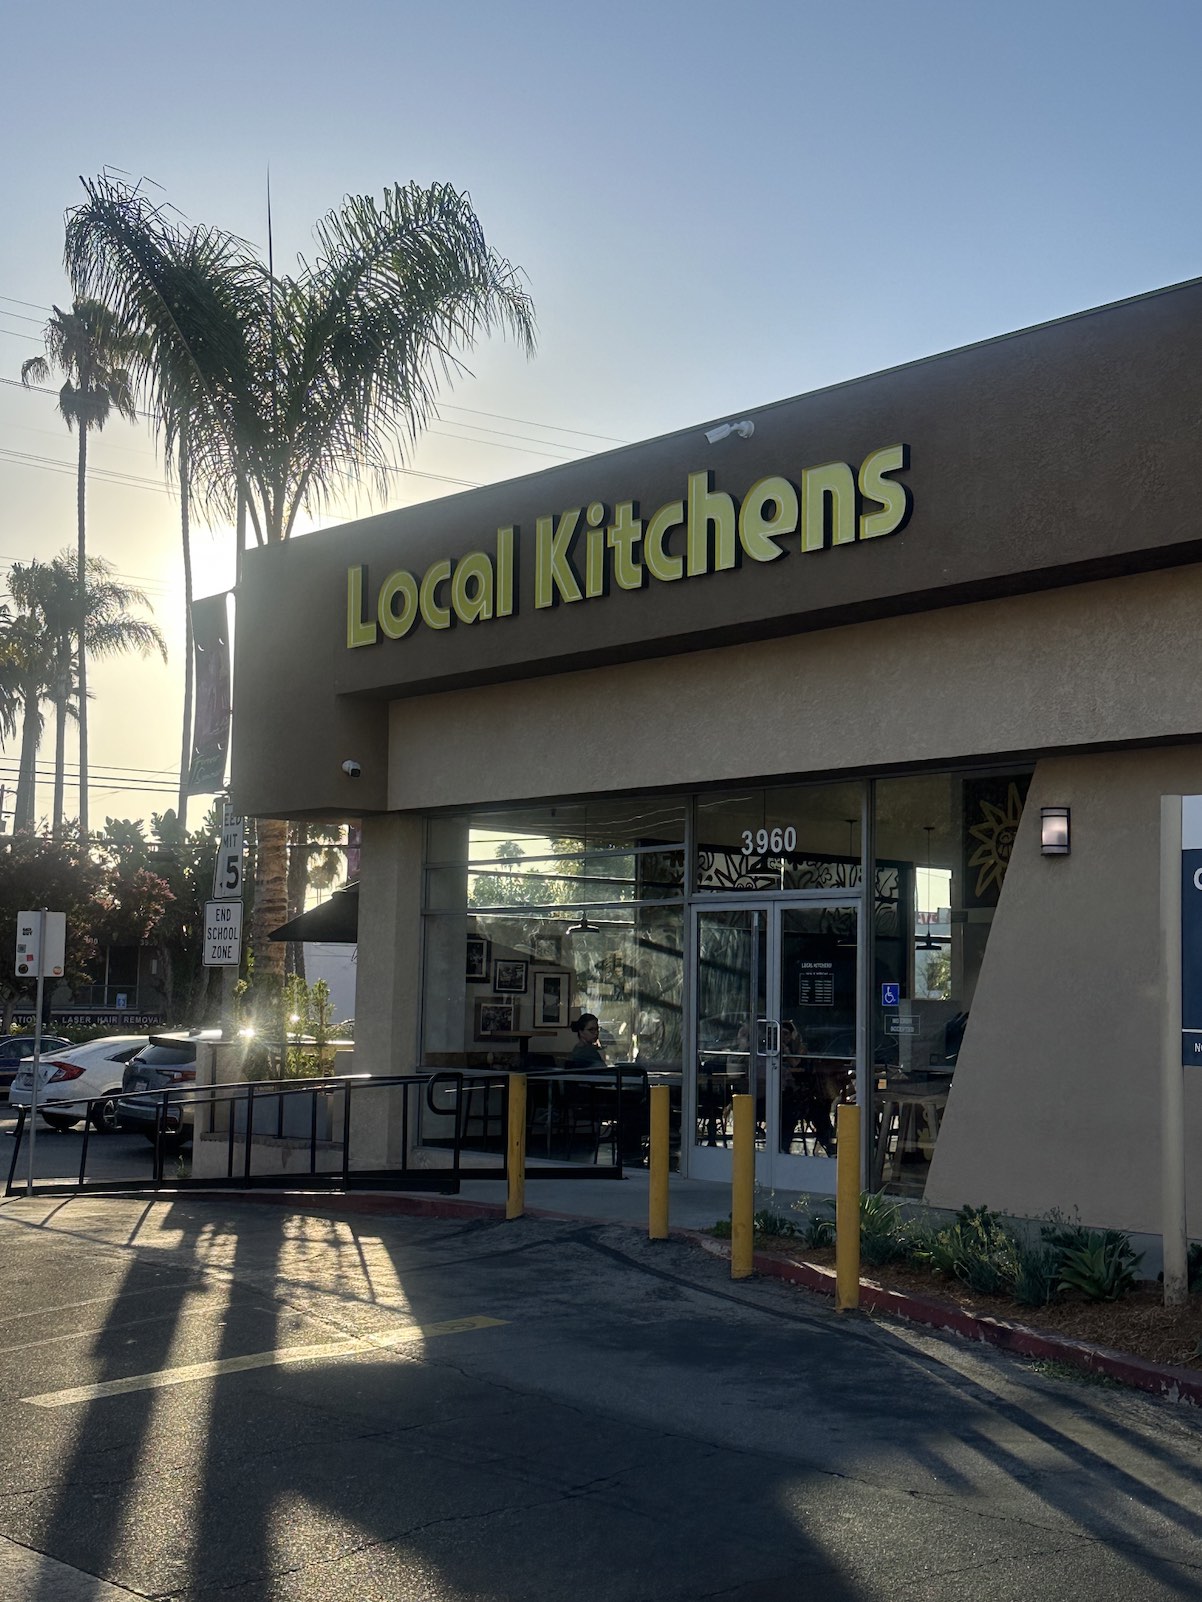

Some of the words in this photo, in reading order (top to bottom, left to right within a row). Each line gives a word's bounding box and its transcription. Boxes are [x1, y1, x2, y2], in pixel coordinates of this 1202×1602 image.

[347, 525, 516, 649] Local
[534, 443, 911, 610] Kitchens
[741, 826, 797, 856] 3960
[225, 855, 240, 889] 5
[215, 908, 232, 922] END
[207, 926, 239, 941] SCHOOL
[211, 945, 233, 959] ZONE
[62, 1016, 92, 1024] LASER
[97, 1016, 118, 1024] HAIR
[124, 1016, 163, 1024] REMOVAL
